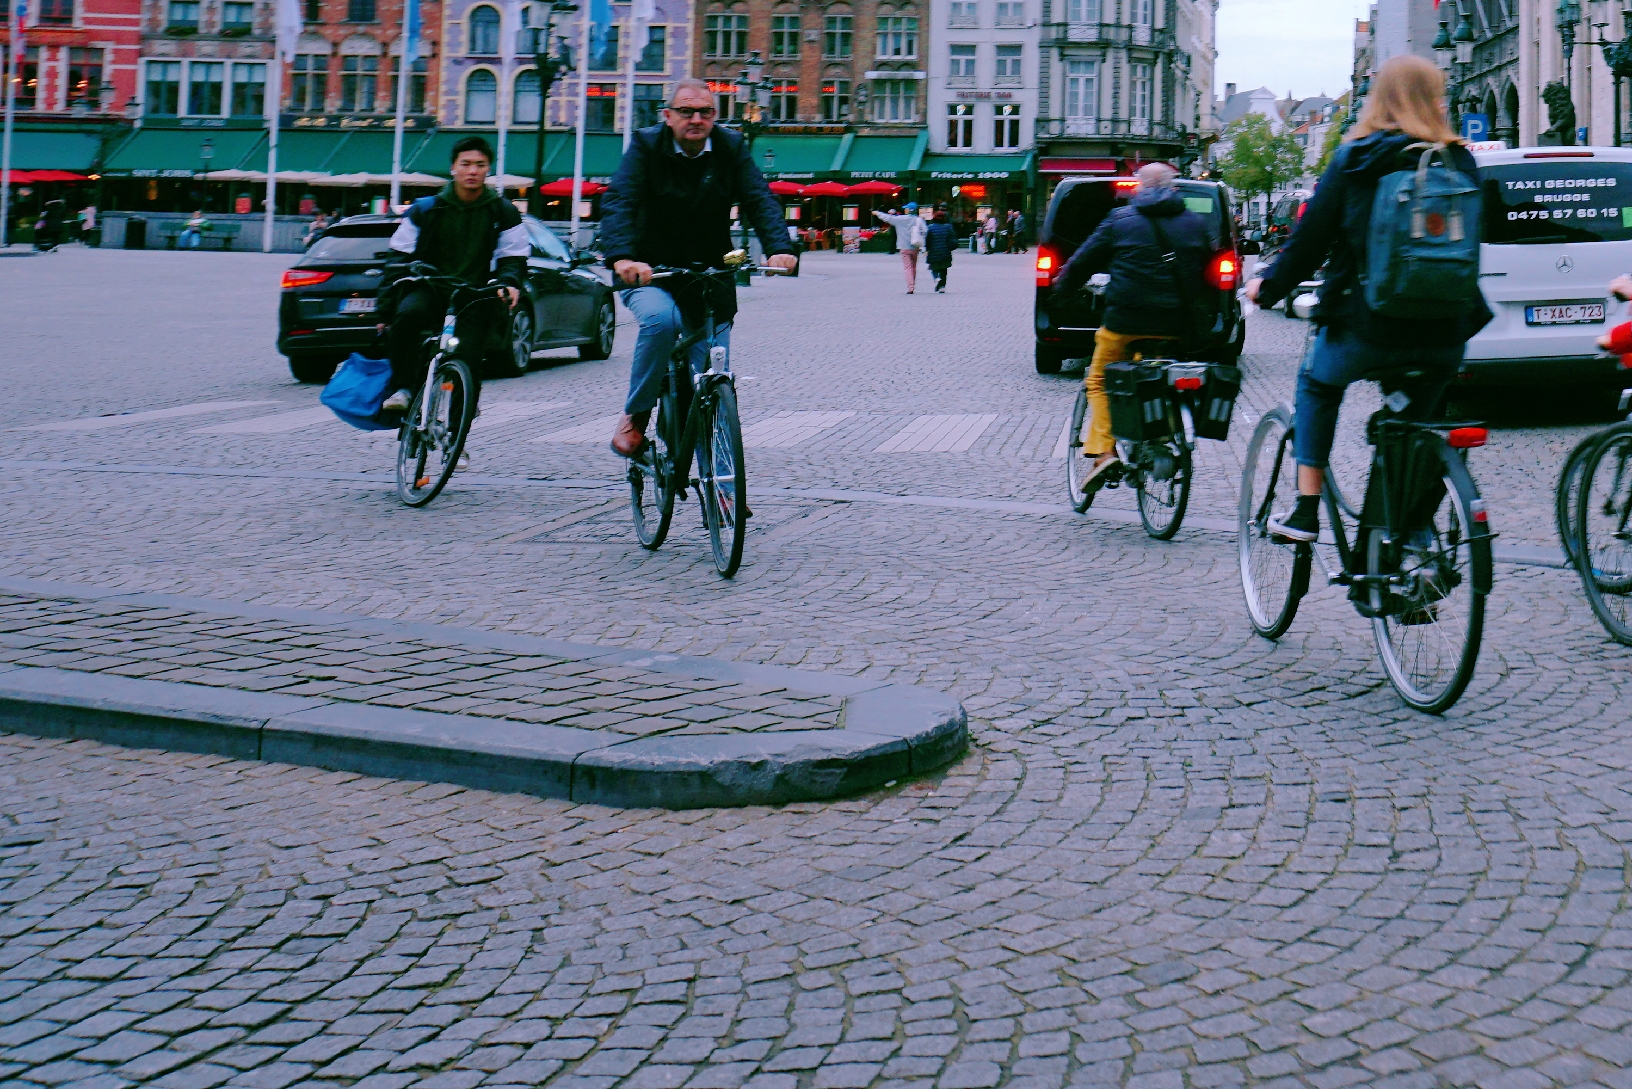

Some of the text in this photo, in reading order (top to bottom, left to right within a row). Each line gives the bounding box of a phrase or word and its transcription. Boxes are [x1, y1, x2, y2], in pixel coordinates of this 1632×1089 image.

[1467, 119, 1483, 140] P
[1469, 144, 1501, 152] TAXI
[1505, 177, 1618, 191] TAXI GEORGES
[1533, 193, 1592, 204] BRUGGE
[1506, 210, 1550, 221] 0475
[1600, 207, 1618, 218] 15
